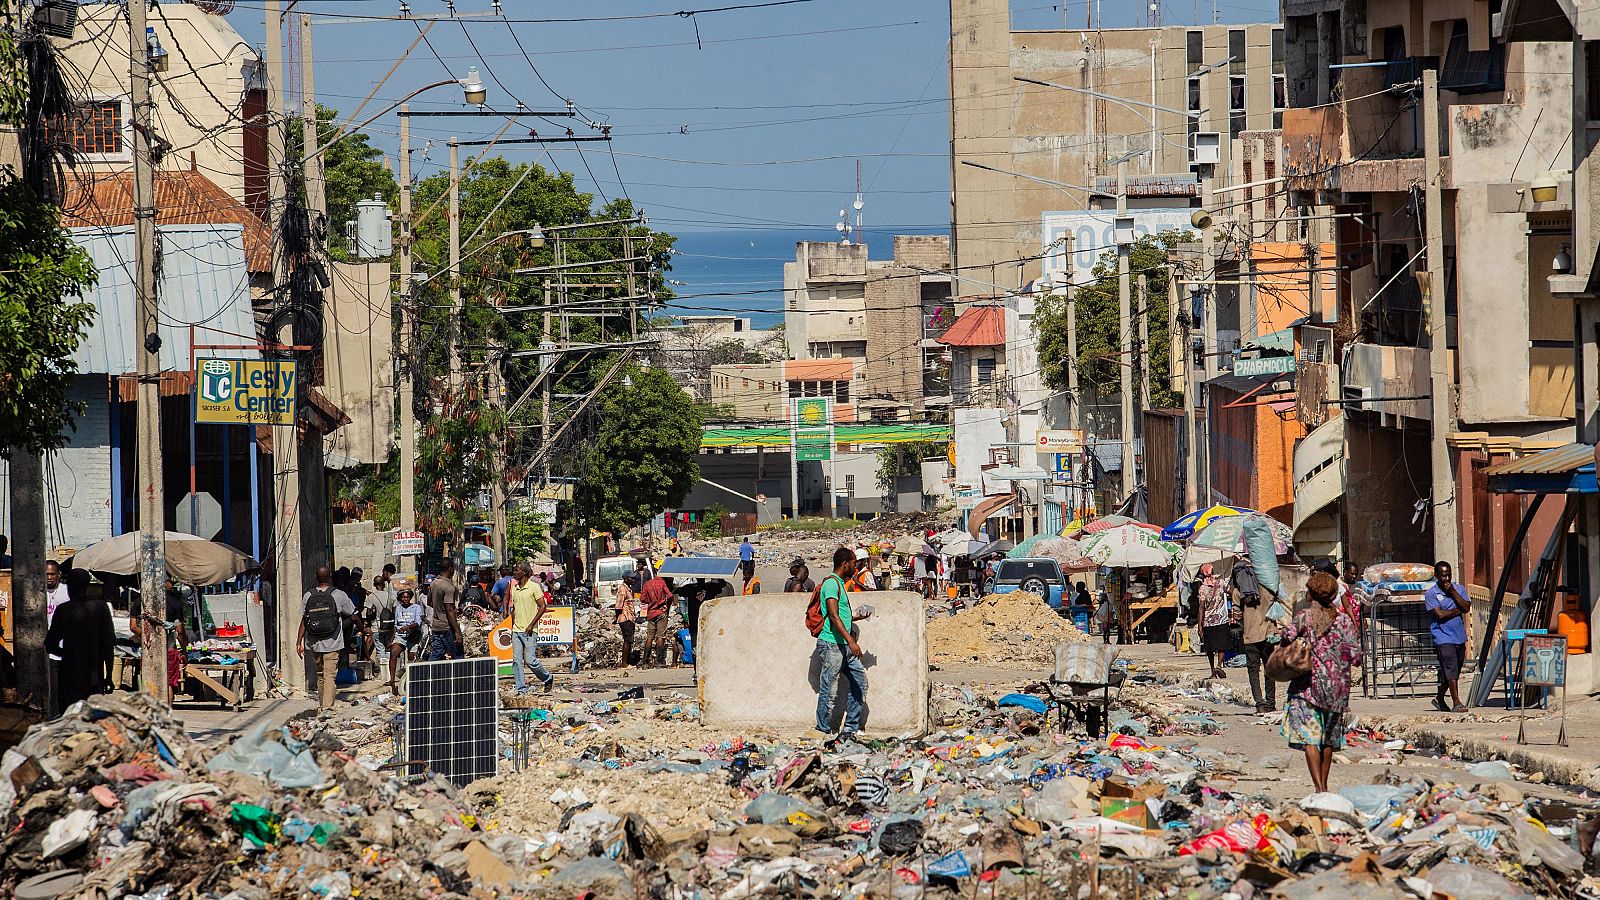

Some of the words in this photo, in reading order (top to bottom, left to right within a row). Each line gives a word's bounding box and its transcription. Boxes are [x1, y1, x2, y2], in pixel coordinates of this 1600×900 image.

[1234, 359, 1295, 375] PHARMACIE
[234, 361, 295, 397] Lesly
[234, 390, 294, 413] Center
[1532, 637, 1552, 648] CLEF
